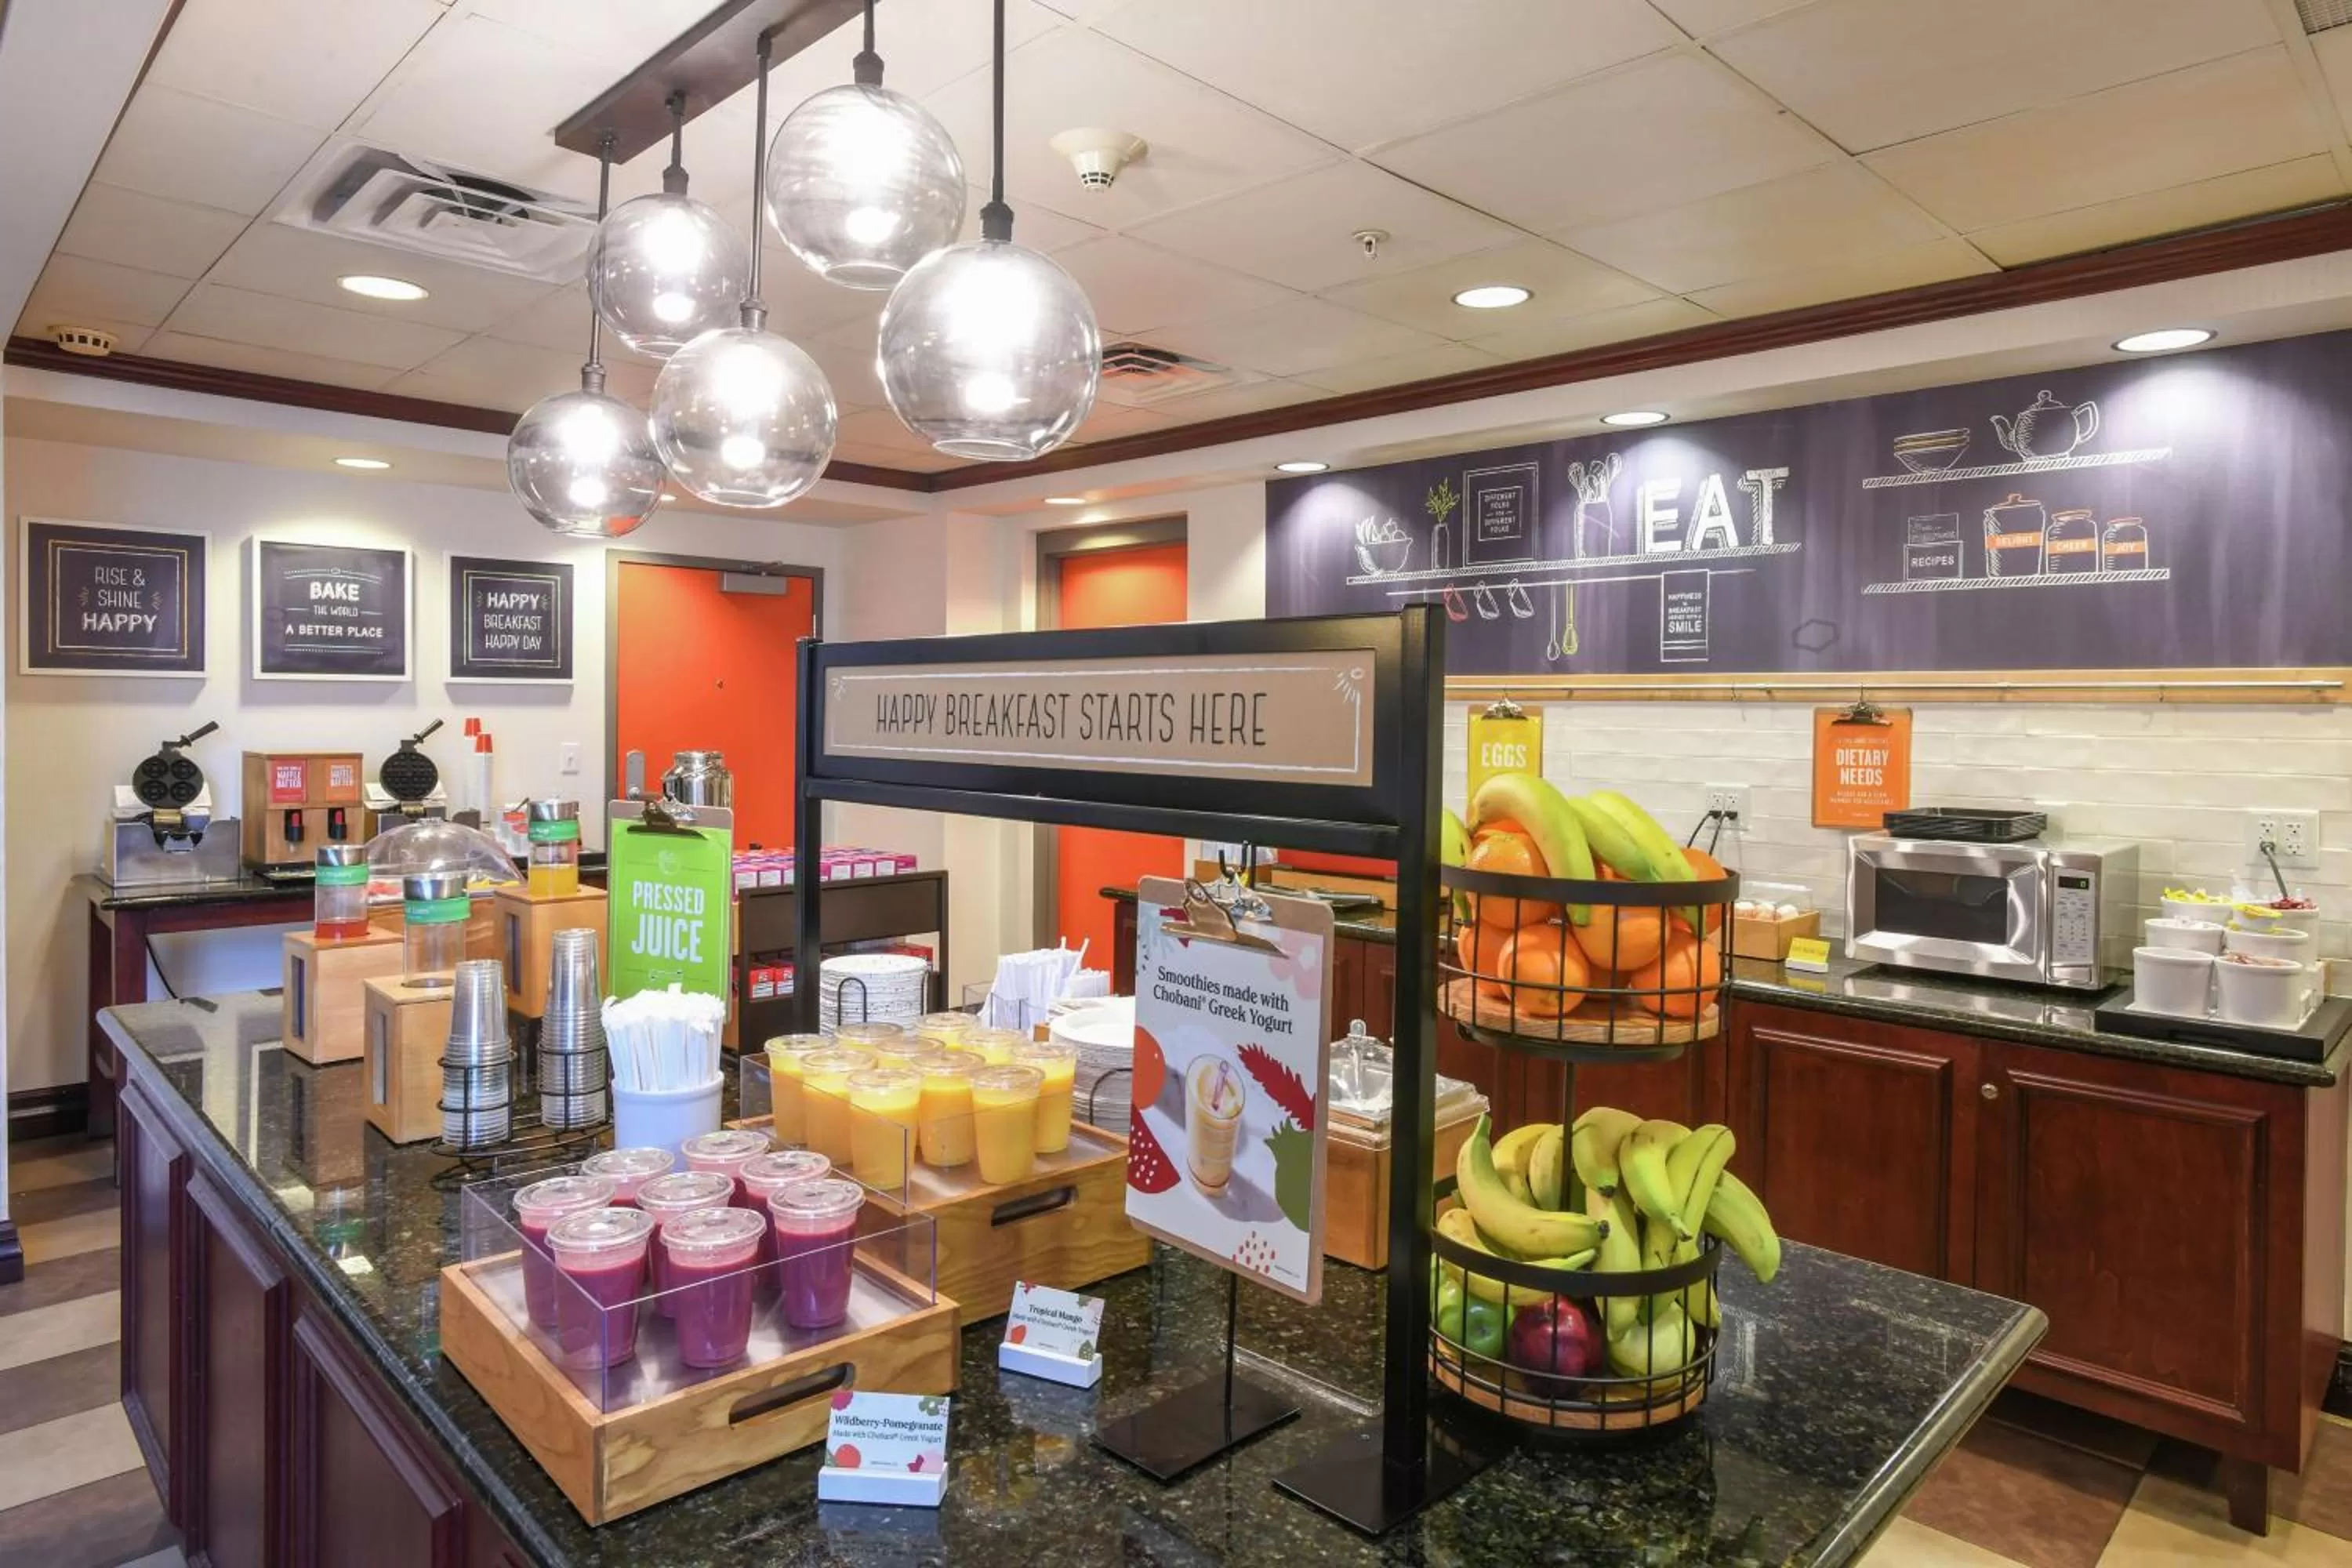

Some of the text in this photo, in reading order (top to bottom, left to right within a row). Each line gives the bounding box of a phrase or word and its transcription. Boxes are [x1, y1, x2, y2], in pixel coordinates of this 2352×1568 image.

[1637, 466, 1789, 554] EAT
[1911, 555, 1955, 568] RECIPES
[95, 567, 145, 586] RISE &
[98, 589, 142, 608] SHINE
[310, 581, 360, 601] BAKE
[488, 592, 540, 610] HAPPY
[314, 605, 358, 617] THE WORLD
[82, 612, 157, 633] HAPPY
[285, 624, 383, 637] A BETTER PLACE
[484, 614, 543, 630] BREAKFAST
[1668, 620, 1702, 633] SMILE
[485, 633, 542, 650] HAPPY DAY
[876, 693, 1267, 746] HAPPY BREAKFAST STARTS HERE
[1482, 742, 1526, 768] EGGS
[1835, 747, 1889, 766] DIETARY
[1839, 768, 1883, 786] NEEDS
[633, 880, 704, 916] PRESSED
[631, 913, 703, 964] JUICE
[1158, 965, 1289, 1012] Smoothies made with
[1208, 998, 1247, 1022] Greek
[1250, 1008, 1293, 1035] Yogurt
[1029, 1305, 1083, 1323] Tropical Mango
[834, 1415, 943, 1431] Wildberry-Pomegranate
